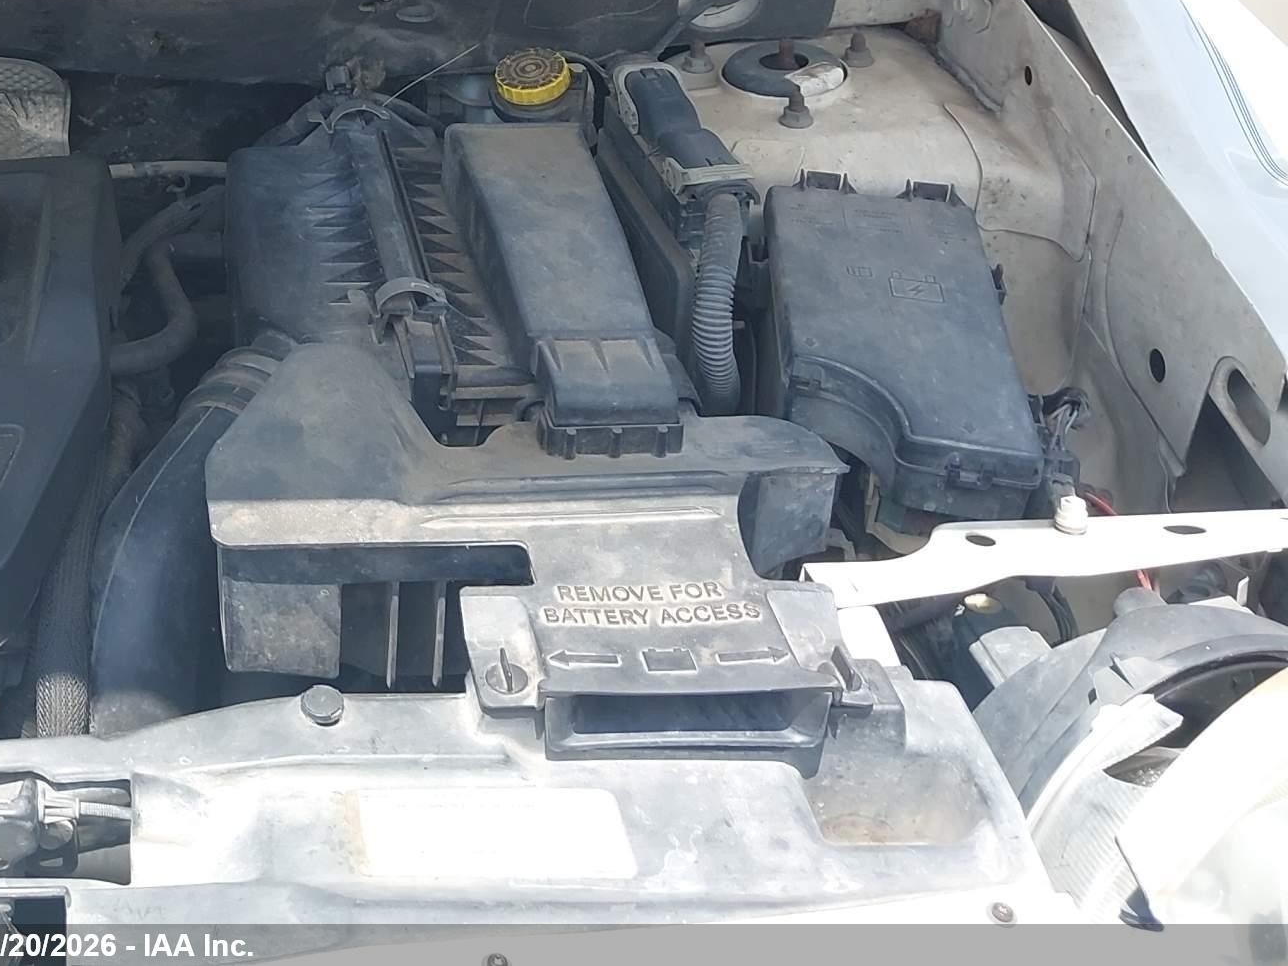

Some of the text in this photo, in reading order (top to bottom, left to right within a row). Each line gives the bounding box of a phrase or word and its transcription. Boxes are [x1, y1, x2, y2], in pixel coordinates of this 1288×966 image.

[555, 581, 723, 603] REMOVE FOR
[543, 602, 761, 626] BATTERY ACCESS
